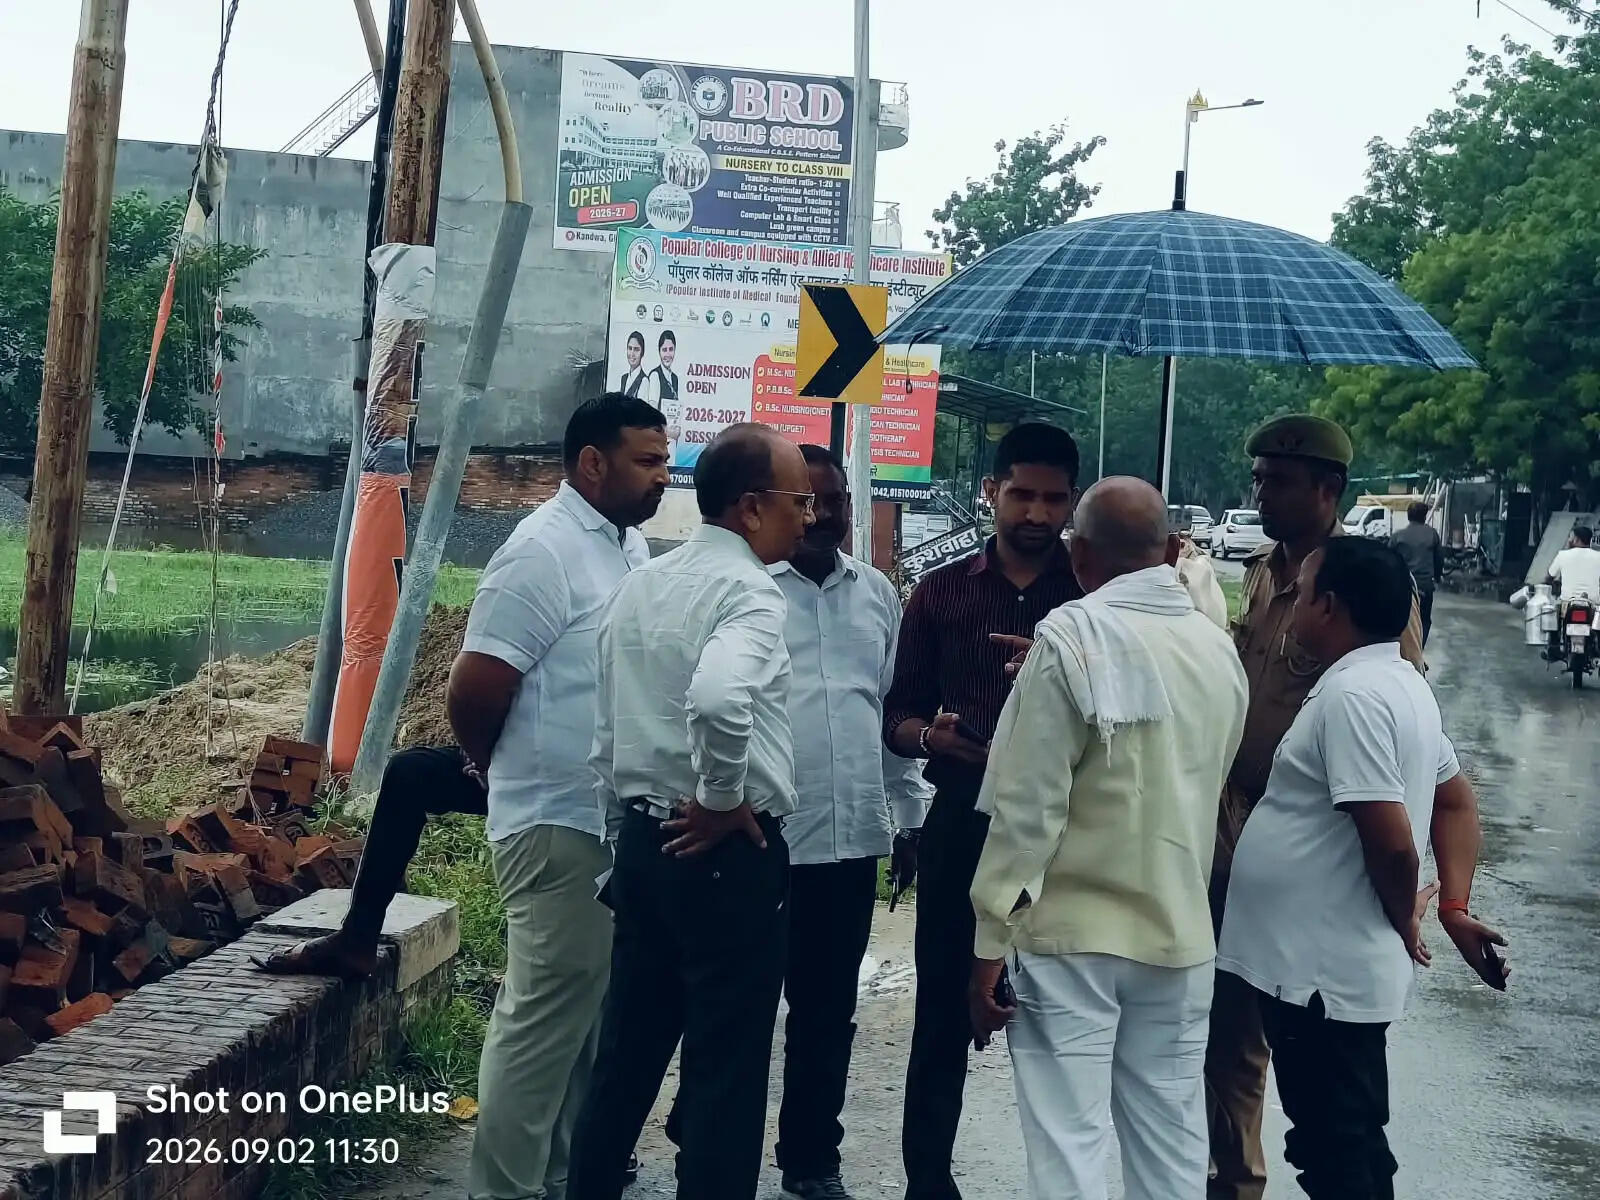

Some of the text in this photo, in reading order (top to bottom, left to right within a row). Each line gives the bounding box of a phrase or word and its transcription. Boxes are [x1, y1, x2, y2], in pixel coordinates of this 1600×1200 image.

[729, 77, 844, 126] BRD
[700, 119, 842, 151] PUBLIC SCHOOL
[819, 152, 841, 160] School
[725, 157, 843, 177] NURSERY TO CLASS VIII
[570, 167, 633, 186] ADMISSION
[819, 179, 834, 187] 1:20
[740, 183, 757, 192] Extra
[569, 185, 612, 208] OPEN
[717, 190, 732, 199] Well
[804, 196, 833, 206] Teachers
[589, 207, 626, 219] 2026-27
[740, 210, 772, 221] Computer
[773, 212, 785, 221] Lab
[777, 203, 808, 214] Transport
[769, 221, 785, 230] Lush
[726, 228, 740, 236] and
[797, 233, 812, 241] with
[812, 234, 831, 243] CCTV
[661, 236, 701, 259] Popular
[704, 240, 744, 261] College
[746, 243, 757, 260] of
[759, 243, 800, 267] Nursing
[802, 250, 809, 266] &
[812, 249, 841, 268] Allied
[901, 257, 946, 277] Institute
[668, 260, 700, 283] पॉपुलर
[702, 263, 734, 282] कॉलेज
[735, 266, 759, 285] ऑफ
[761, 268, 788, 287] नर्सिंग
[699, 286, 731, 299] Institute
[732, 289, 740, 300] of
[742, 291, 772, 302] Medical
[787, 318, 799, 329] ME
[774, 347, 795, 358] Nursin
[891, 358, 926, 368] Healhcare
[686, 363, 751, 380] ADMISSION
[686, 380, 717, 395] OPEN
[684, 407, 746, 424] 2026-2027
[900, 526, 979, 574] कुशवाहा
